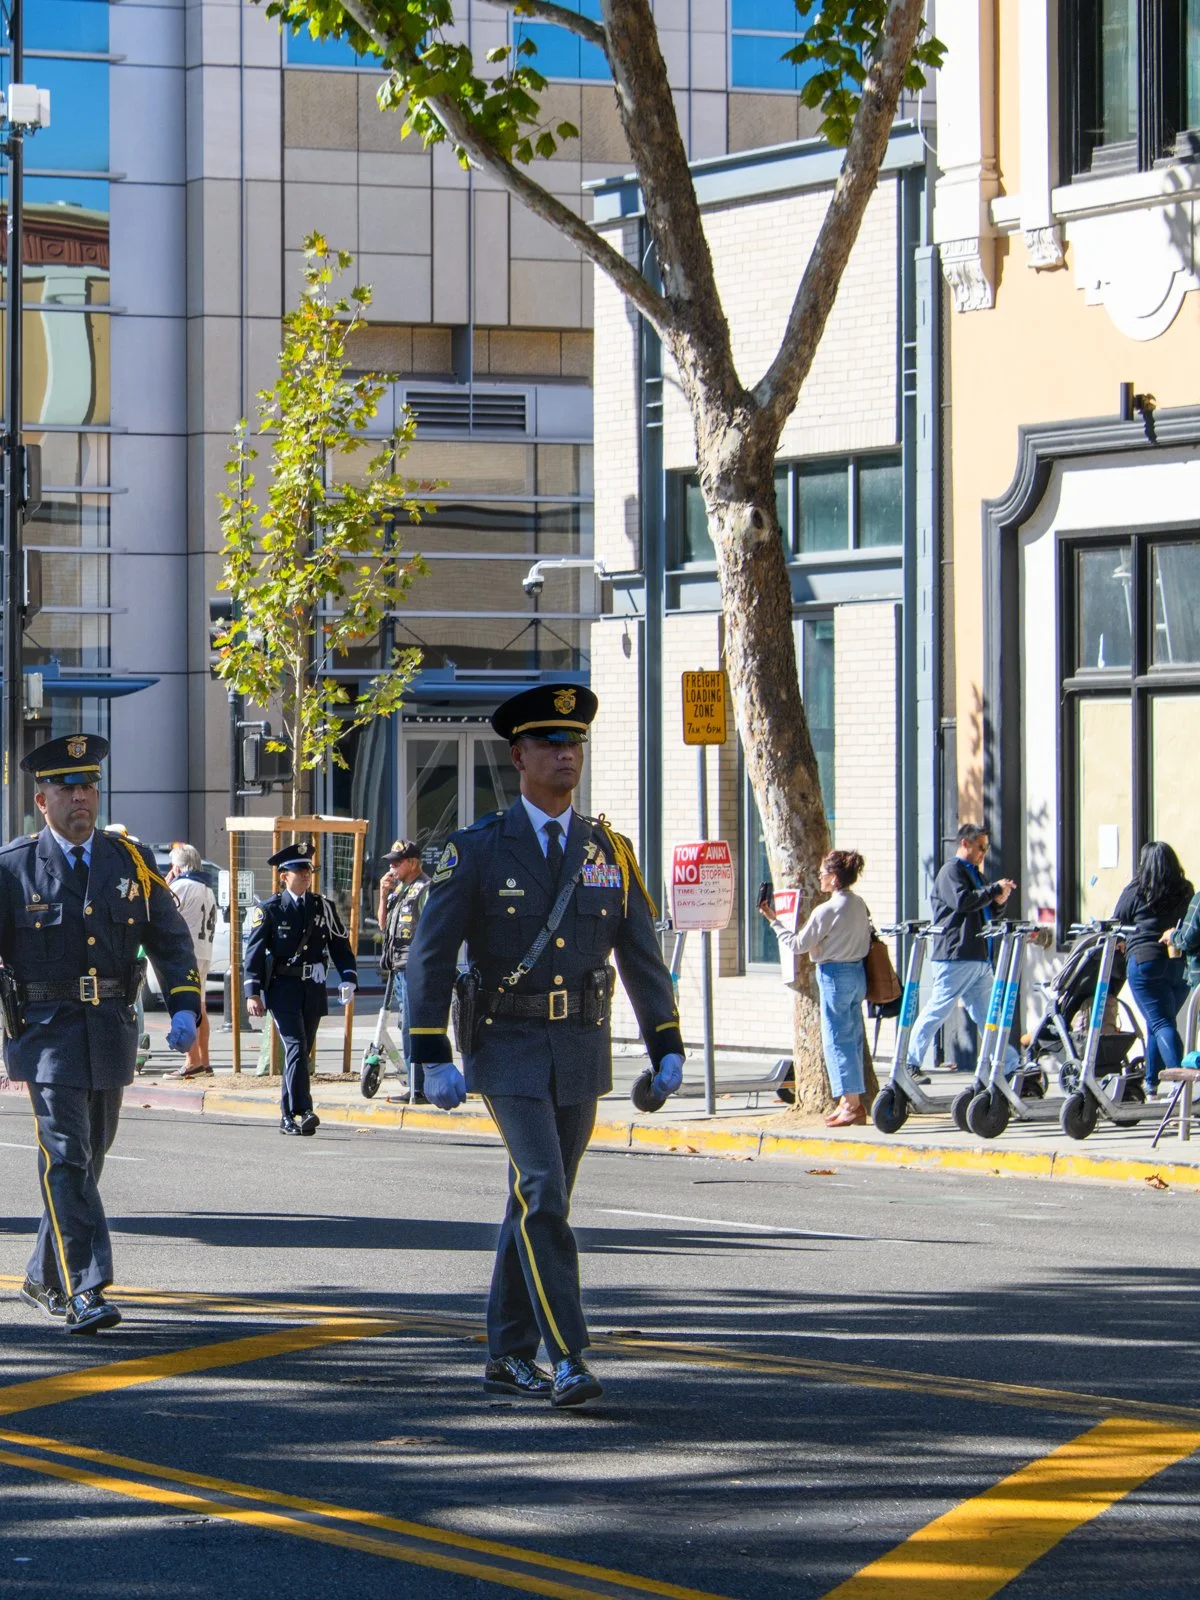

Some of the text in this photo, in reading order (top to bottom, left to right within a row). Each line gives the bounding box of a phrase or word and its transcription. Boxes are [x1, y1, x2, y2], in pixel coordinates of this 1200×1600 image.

[686, 674, 720, 688] FREIGHT
[686, 690, 721, 703] LOADING
[693, 704, 715, 718] ZONE
[675, 846, 698, 861] TOW
[705, 846, 726, 861] AWAY
[675, 864, 698, 883] NO
[701, 868, 731, 880] STOPPING
